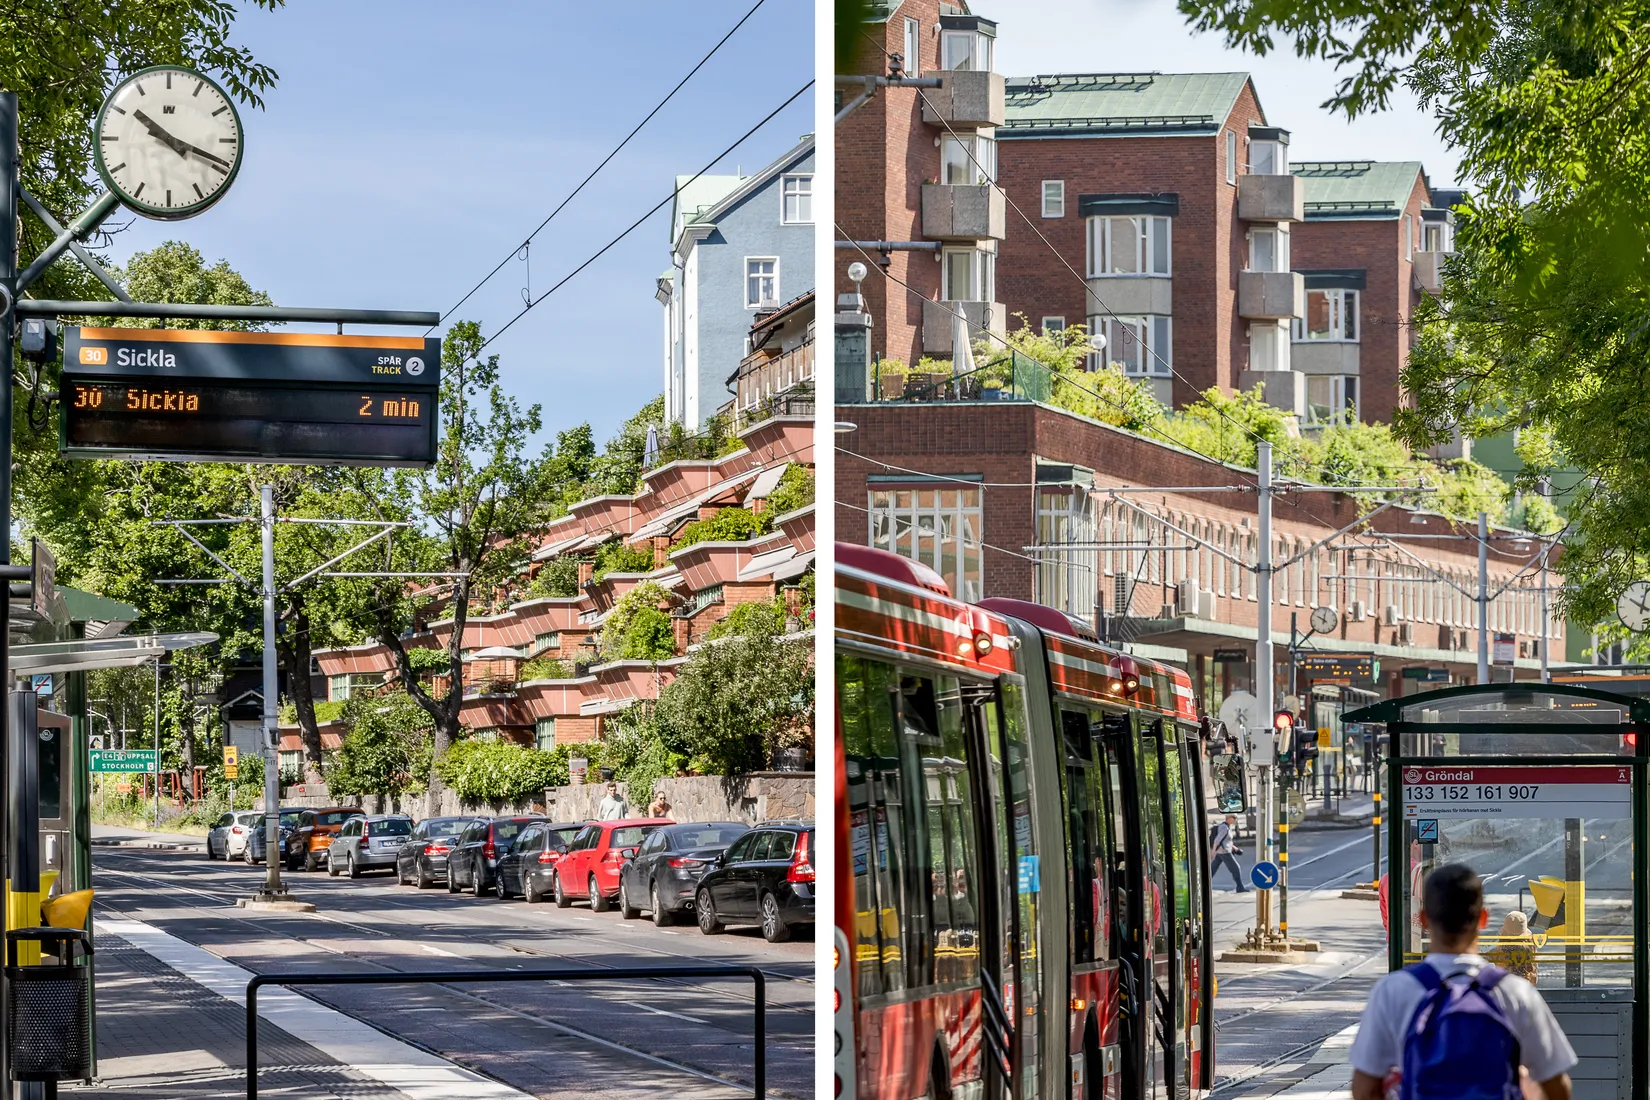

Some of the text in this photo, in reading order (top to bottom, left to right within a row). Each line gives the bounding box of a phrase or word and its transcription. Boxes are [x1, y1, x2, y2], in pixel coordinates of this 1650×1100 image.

[85, 348, 176, 367] 30 Sickla
[378, 355, 402, 365] SPÅR
[371, 366, 402, 375] TRACK
[411, 361, 419, 372] 2
[359, 396, 419, 417] 2 min
[1425, 770, 1474, 781] Gröndal
[1406, 785, 1539, 800] 133 152 161 907
